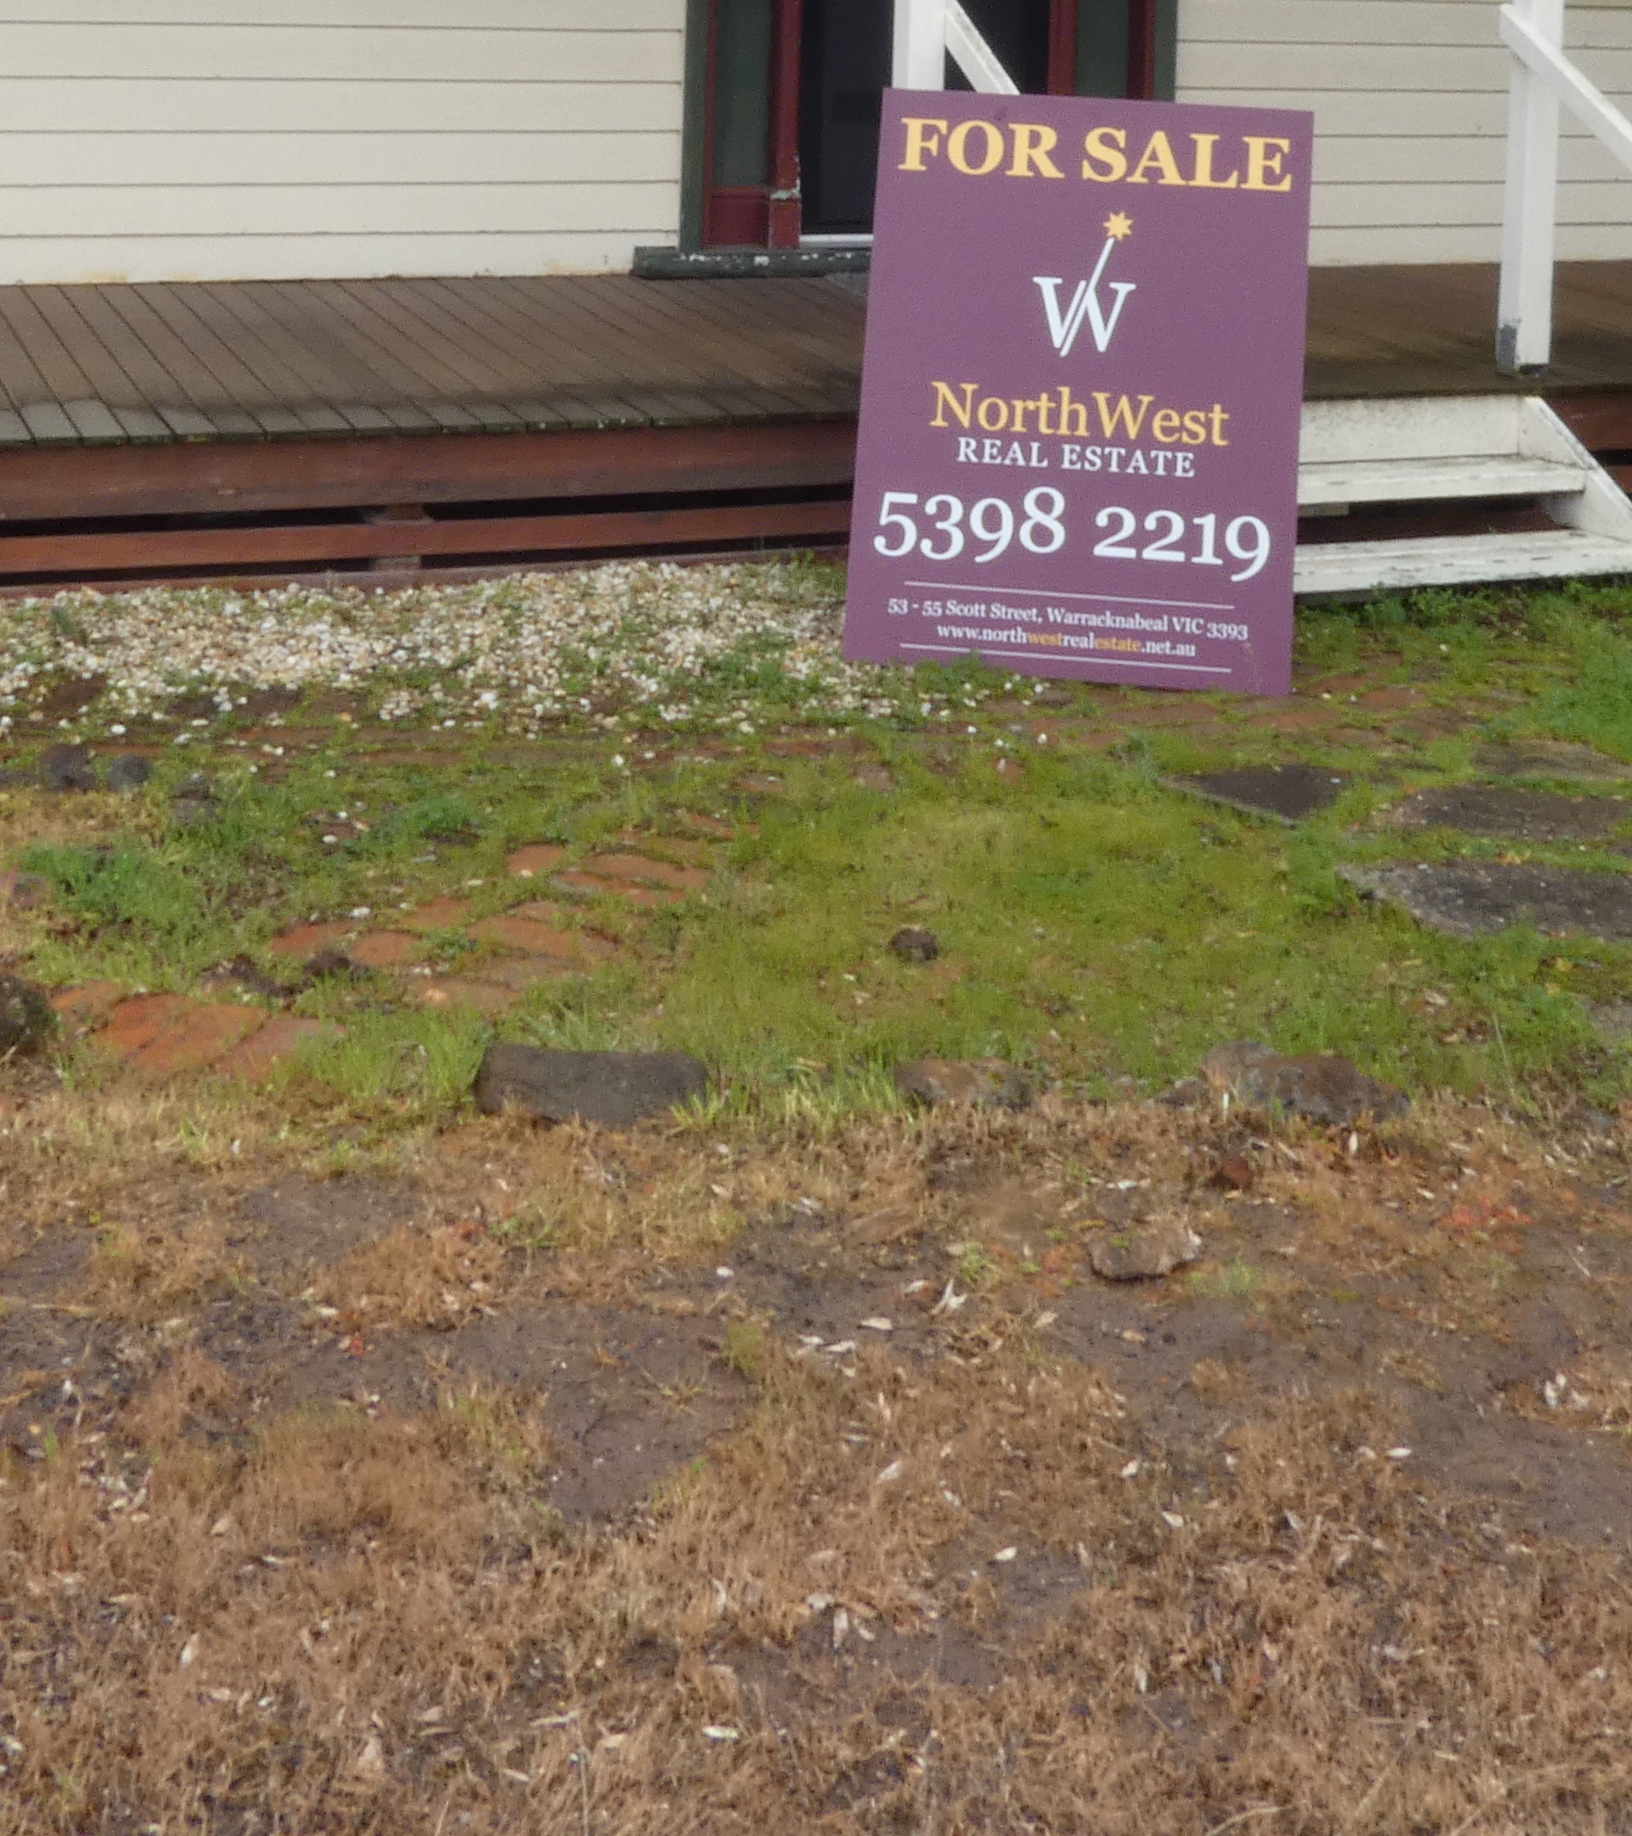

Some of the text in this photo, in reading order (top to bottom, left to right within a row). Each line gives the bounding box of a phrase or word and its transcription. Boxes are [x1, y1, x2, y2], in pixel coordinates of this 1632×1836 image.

[898, 116, 1293, 192] FOR SALE
[930, 381, 1230, 446] NorthWest
[956, 436, 1196, 478] REAL ESTATE
[873, 486, 1271, 583] 5398 2219
[887, 597, 909, 616] 53
[921, 600, 943, 618] 55
[945, 599, 988, 619] Scott
[990, 603, 1044, 625] Street,
[1046, 606, 1169, 633] Warracknabeal
[1171, 617, 1205, 635] VIC
[1206, 623, 1249, 642] 3393
[936, 622, 1197, 657] www.northwestrealestate.net.au
